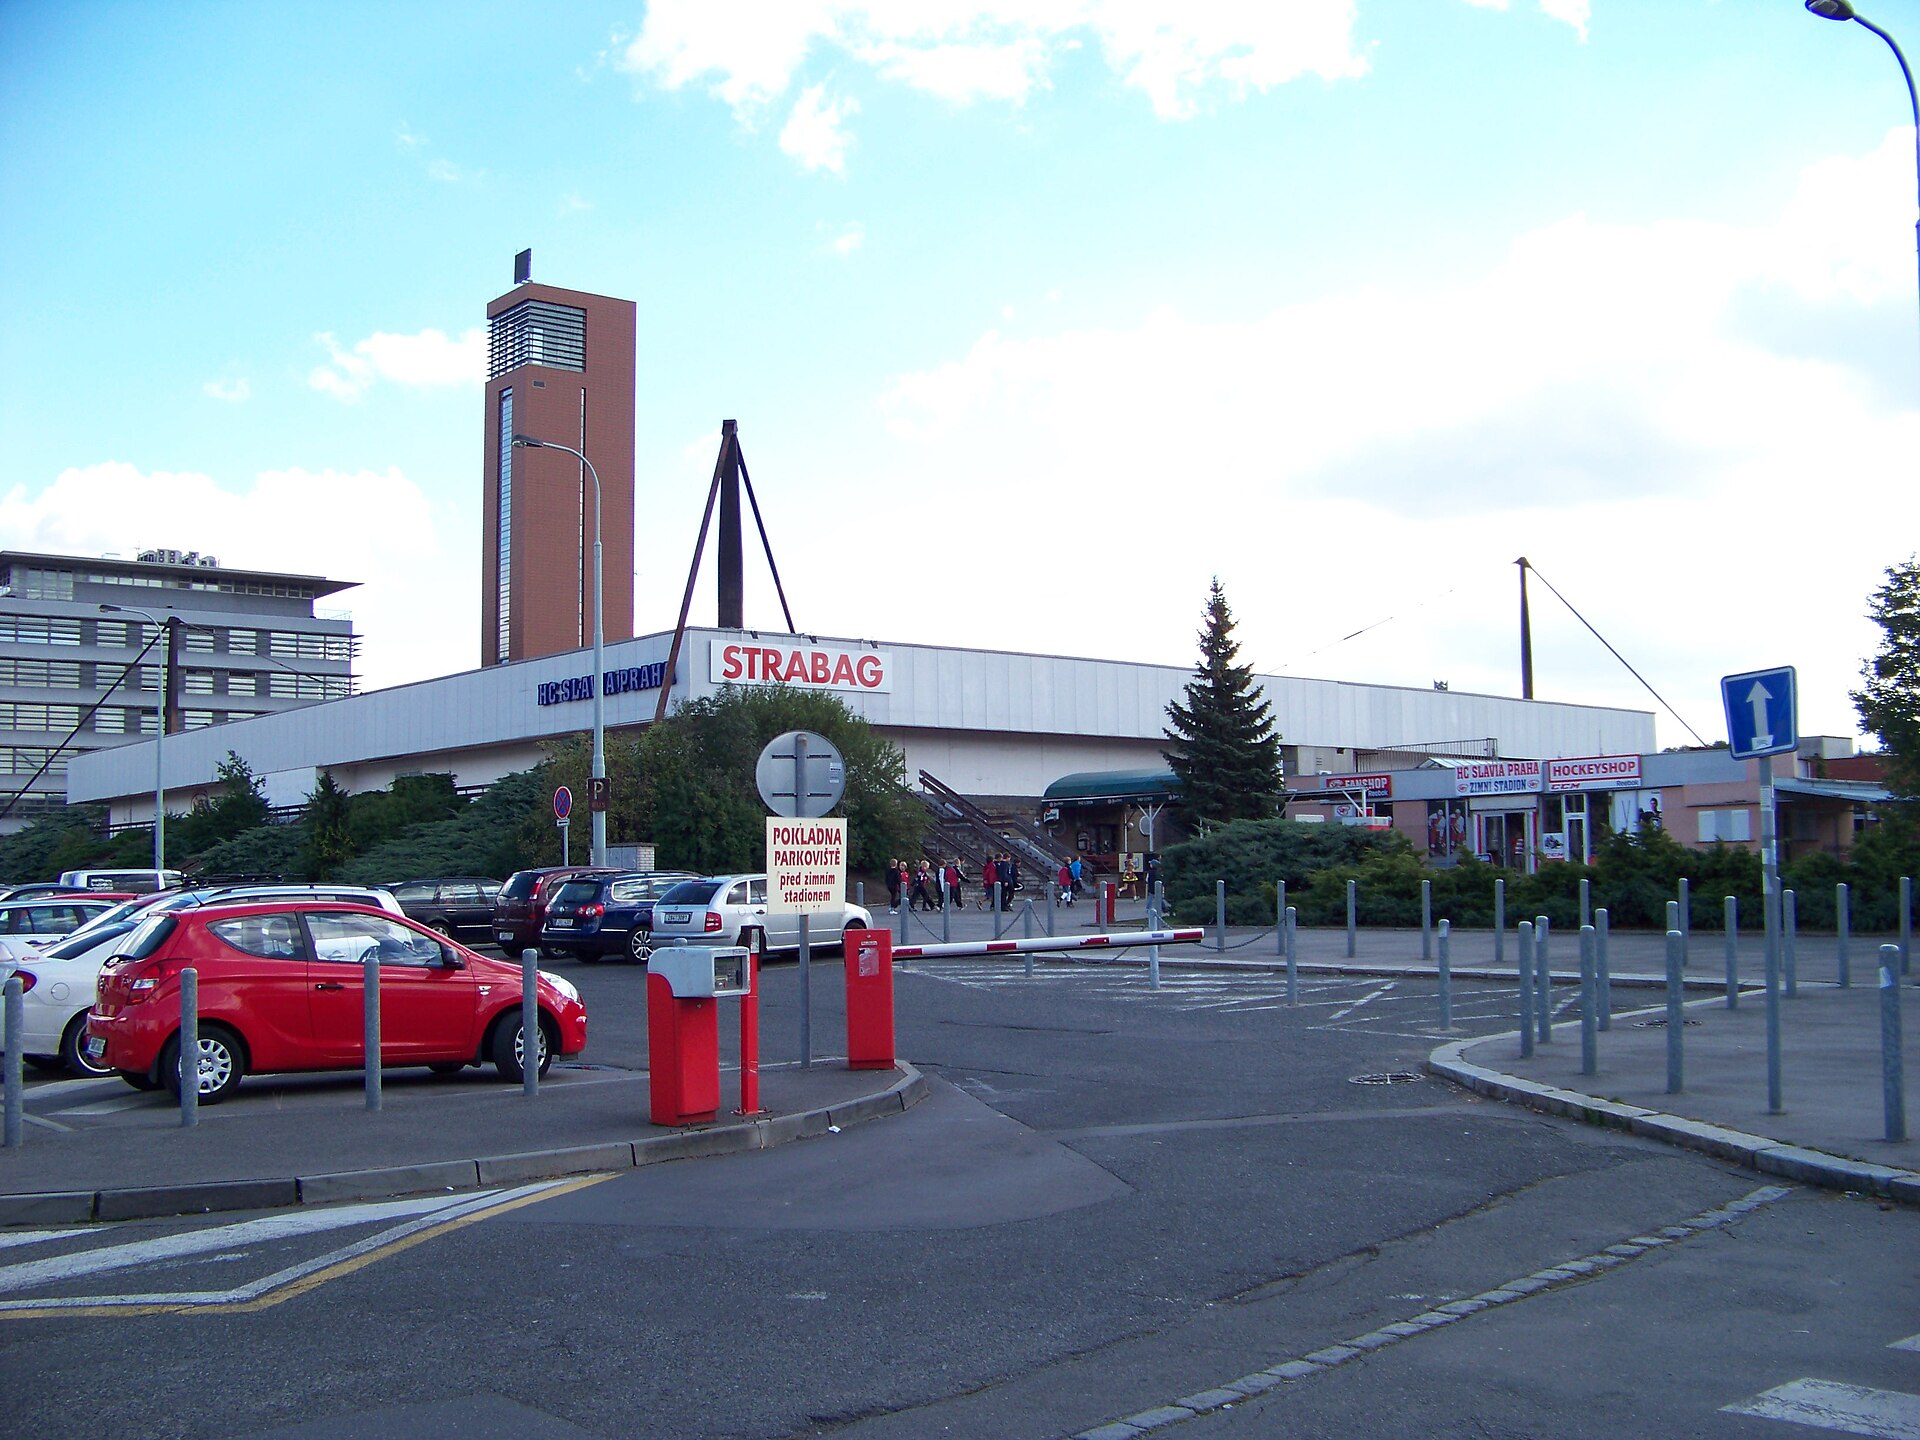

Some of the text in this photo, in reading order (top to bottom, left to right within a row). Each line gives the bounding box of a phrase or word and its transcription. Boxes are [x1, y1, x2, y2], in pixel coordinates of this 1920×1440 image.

[722, 645, 884, 688] STRABAG
[538, 682, 559, 706] HC
[1457, 762, 1540, 779] HC SLAVIA PRAHA
[1553, 761, 1635, 776] HOCKEYSHOP
[593, 781, 604, 800] P
[1345, 777, 1388, 789] FANSHOP
[1494, 779, 1527, 792] STADION
[1551, 782, 1581, 790] CCM
[773, 827, 842, 845] POKLADNA
[774, 846, 840, 866] PARKOVIŠTĚ
[780, 871, 836, 890] před zimním
[784, 888, 831, 903] stadionem
